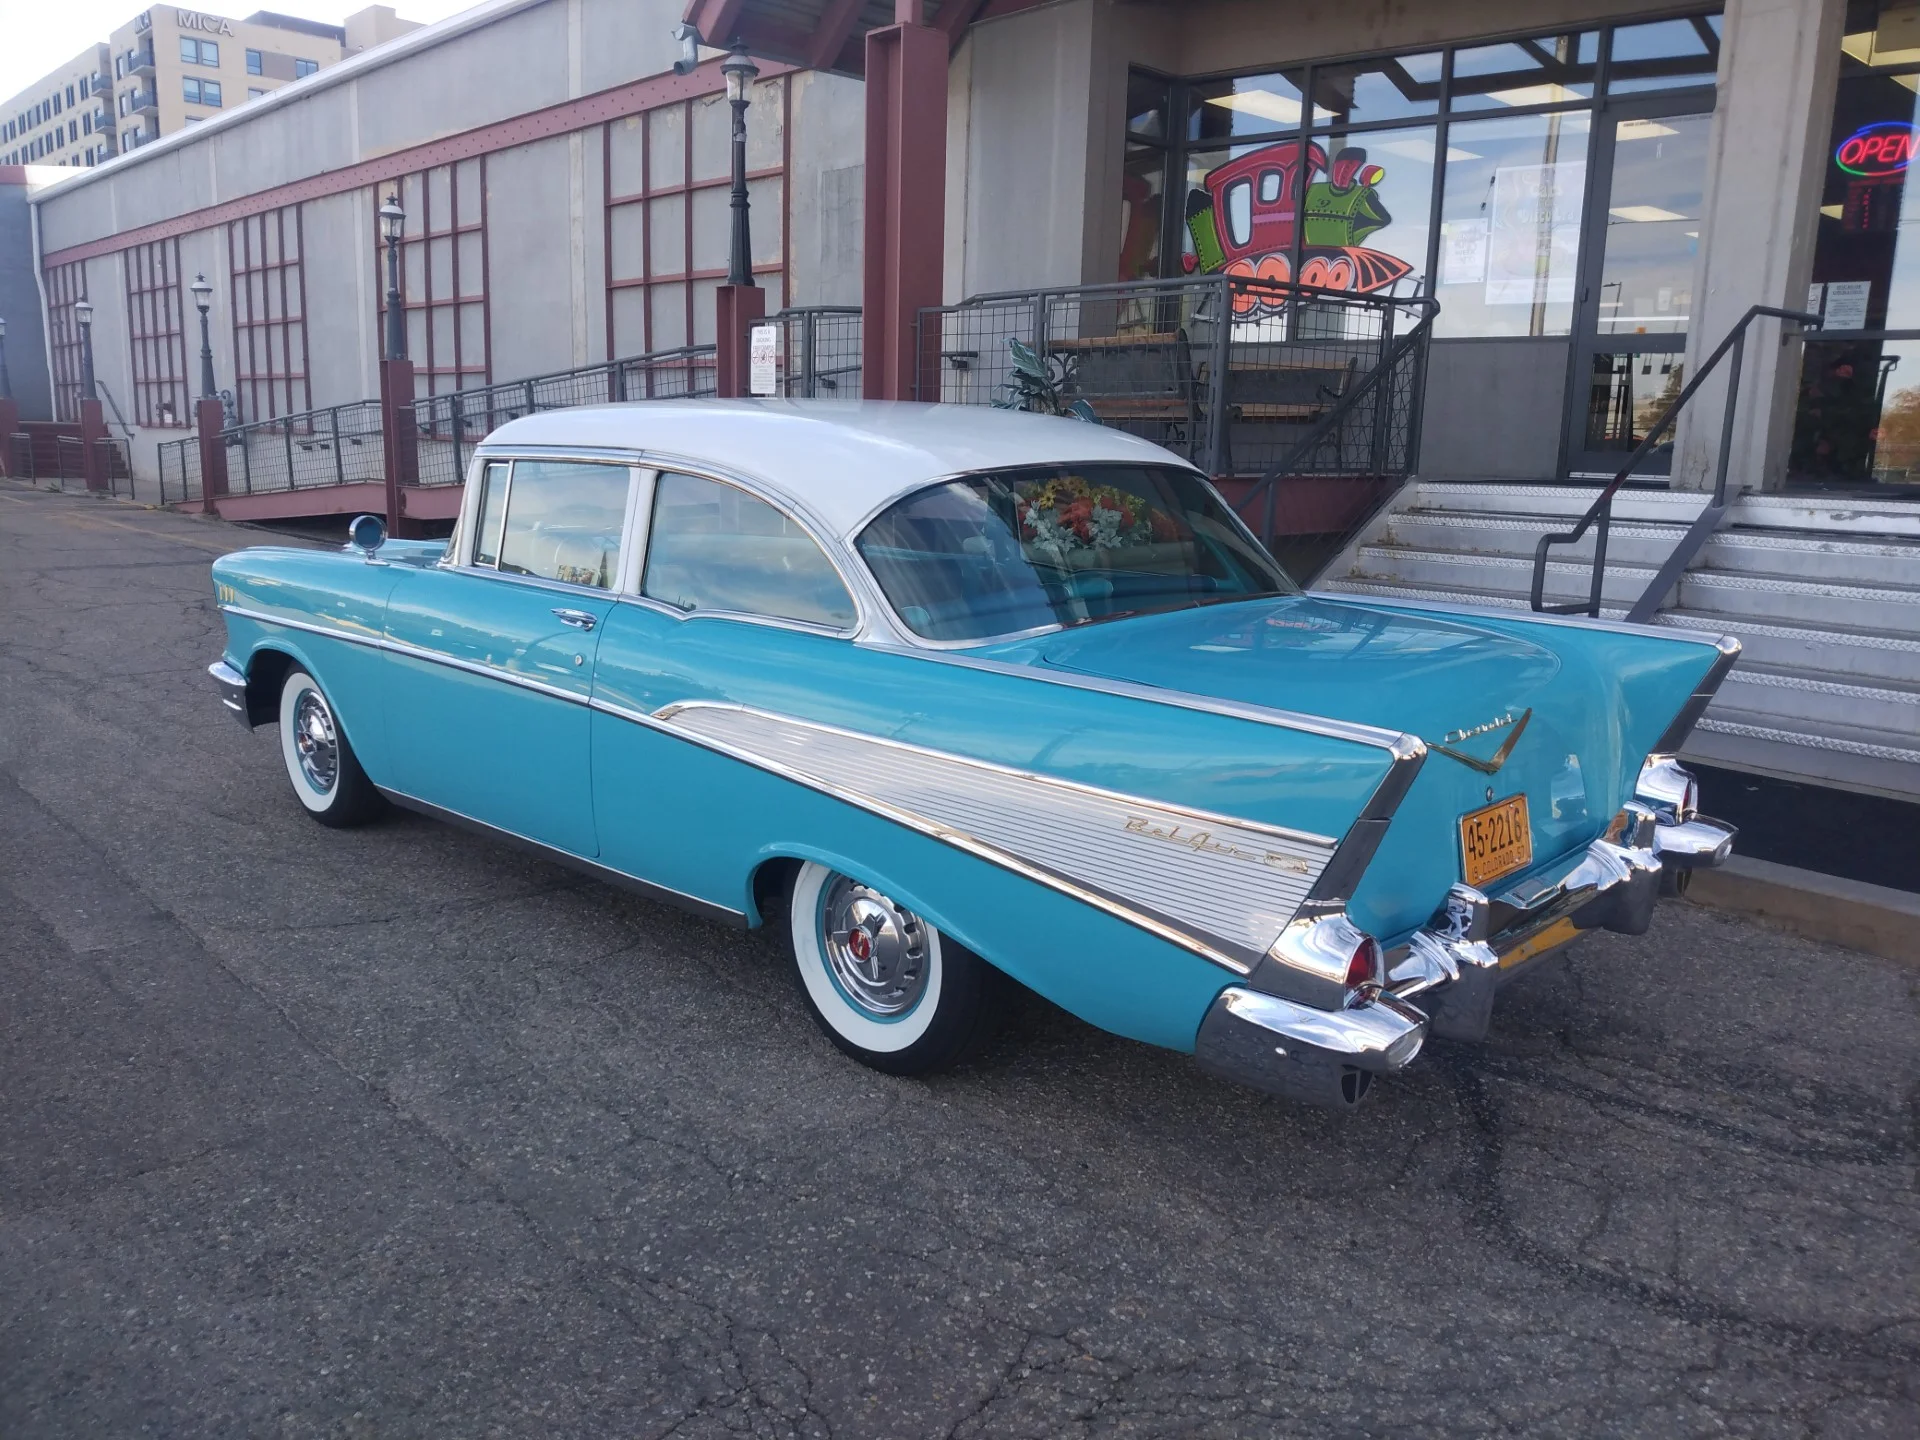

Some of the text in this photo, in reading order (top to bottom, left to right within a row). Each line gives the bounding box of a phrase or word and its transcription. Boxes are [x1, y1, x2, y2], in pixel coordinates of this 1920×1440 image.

[177, 8, 234, 37] MICA
[1840, 134, 1920, 165] OPEN
[1444, 713, 1517, 744] Chevrolet
[1483, 850, 1514, 875] COLORADO
[1516, 845, 1525, 860] 57
